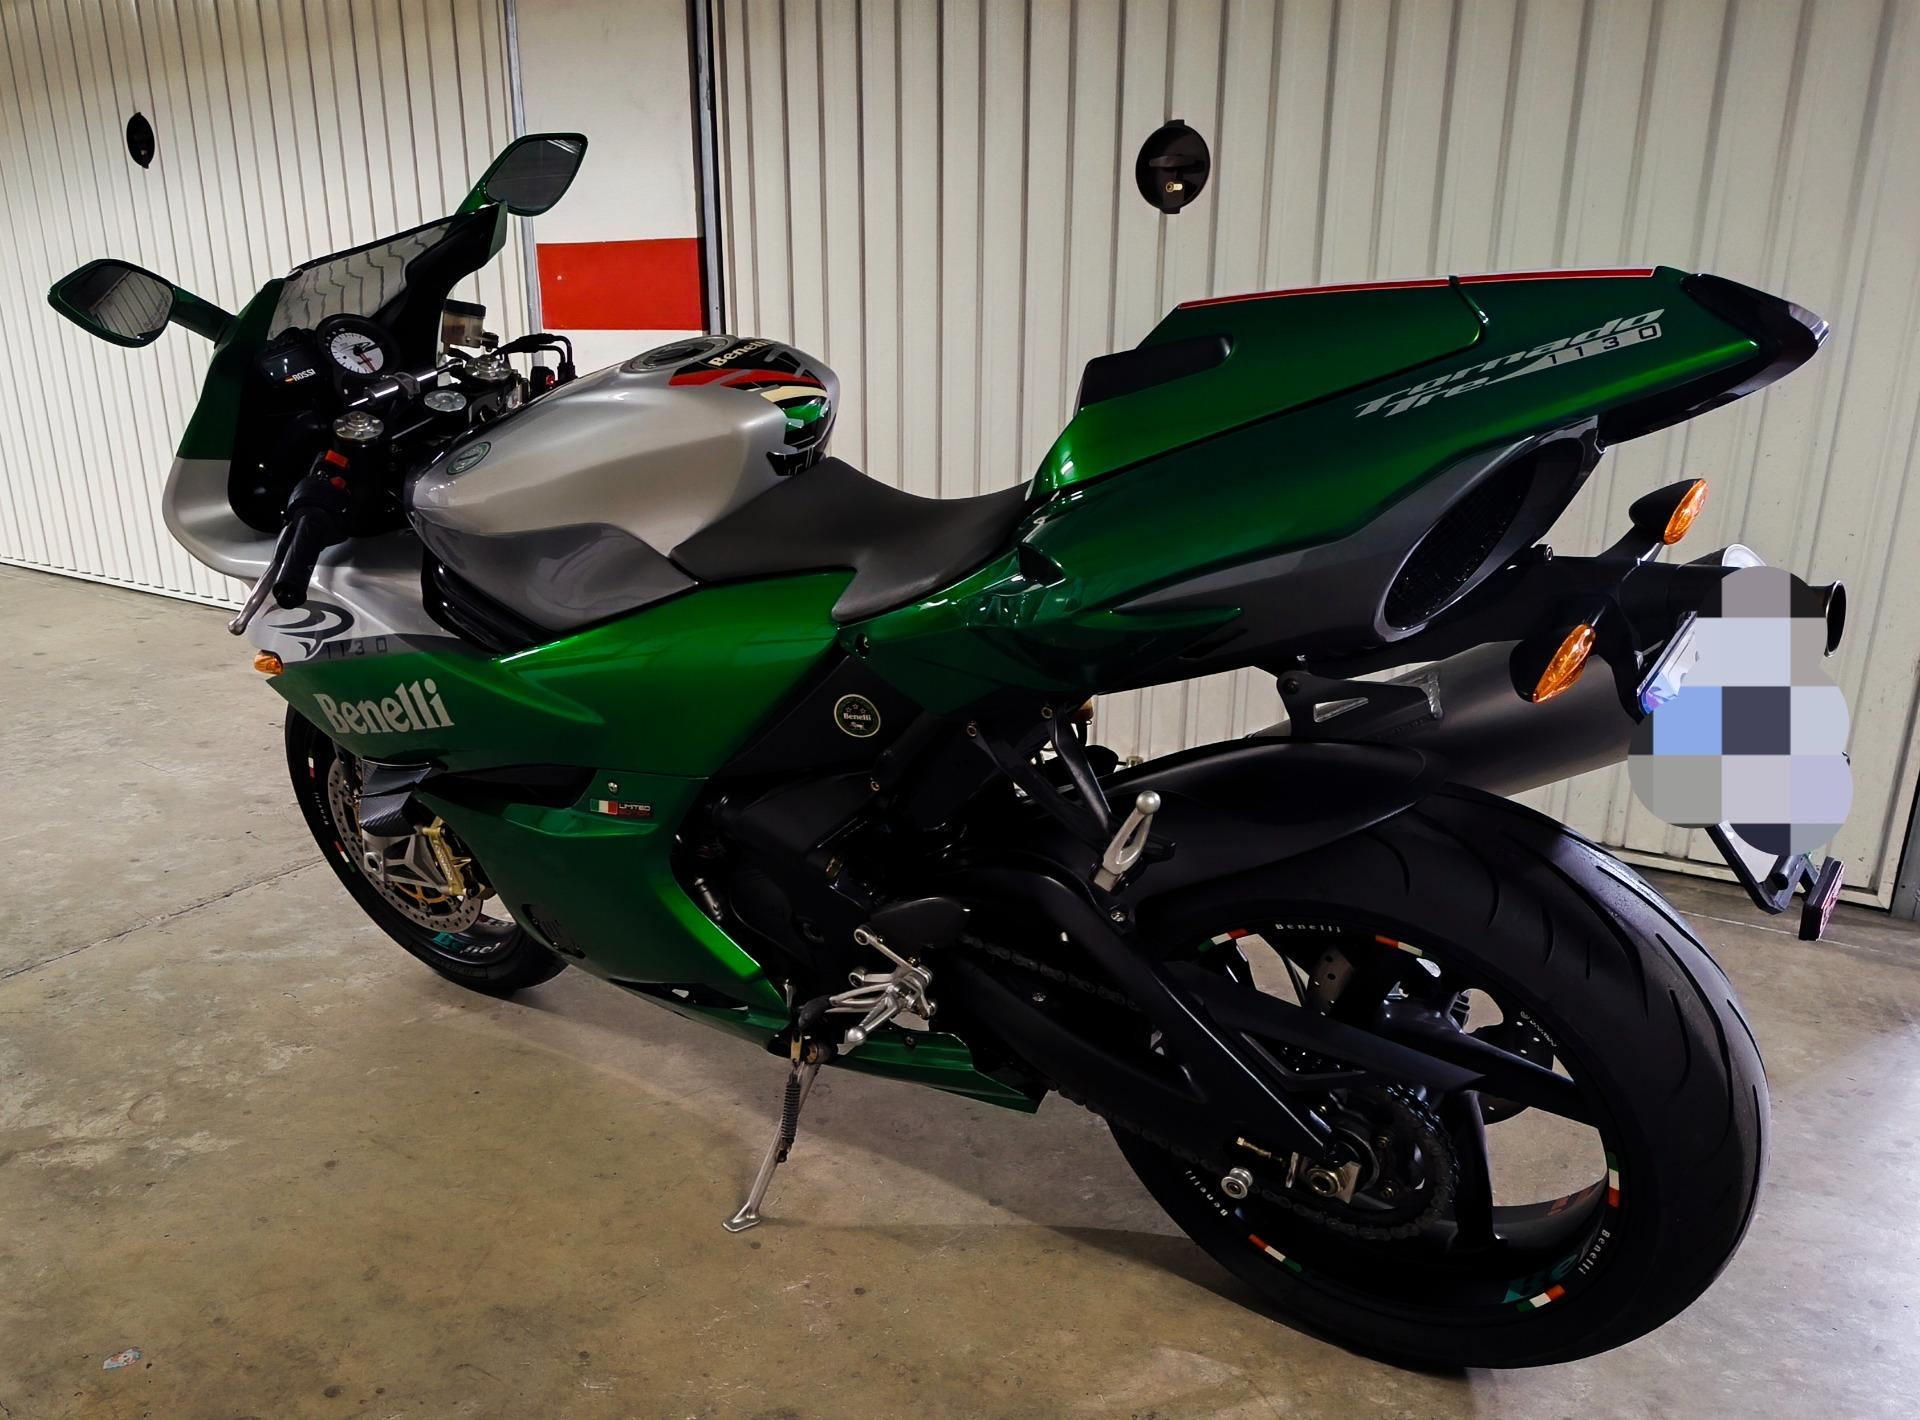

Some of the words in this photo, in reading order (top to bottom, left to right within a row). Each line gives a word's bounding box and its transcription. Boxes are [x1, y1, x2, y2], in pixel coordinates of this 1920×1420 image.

[292, 368, 316, 382] ROSSI
[1354, 309, 1665, 418] Tornado
[1383, 376, 1490, 418] Tre
[1549, 324, 1659, 365] 1130
[325, 636, 389, 660] 1130
[312, 678, 456, 735] Benelli
[843, 712, 872, 721] Benelli
[1275, 922, 1342, 934] Benelli
[1185, 1169, 1229, 1217] Benelli
[1578, 1228, 1611, 1275] Benelli
